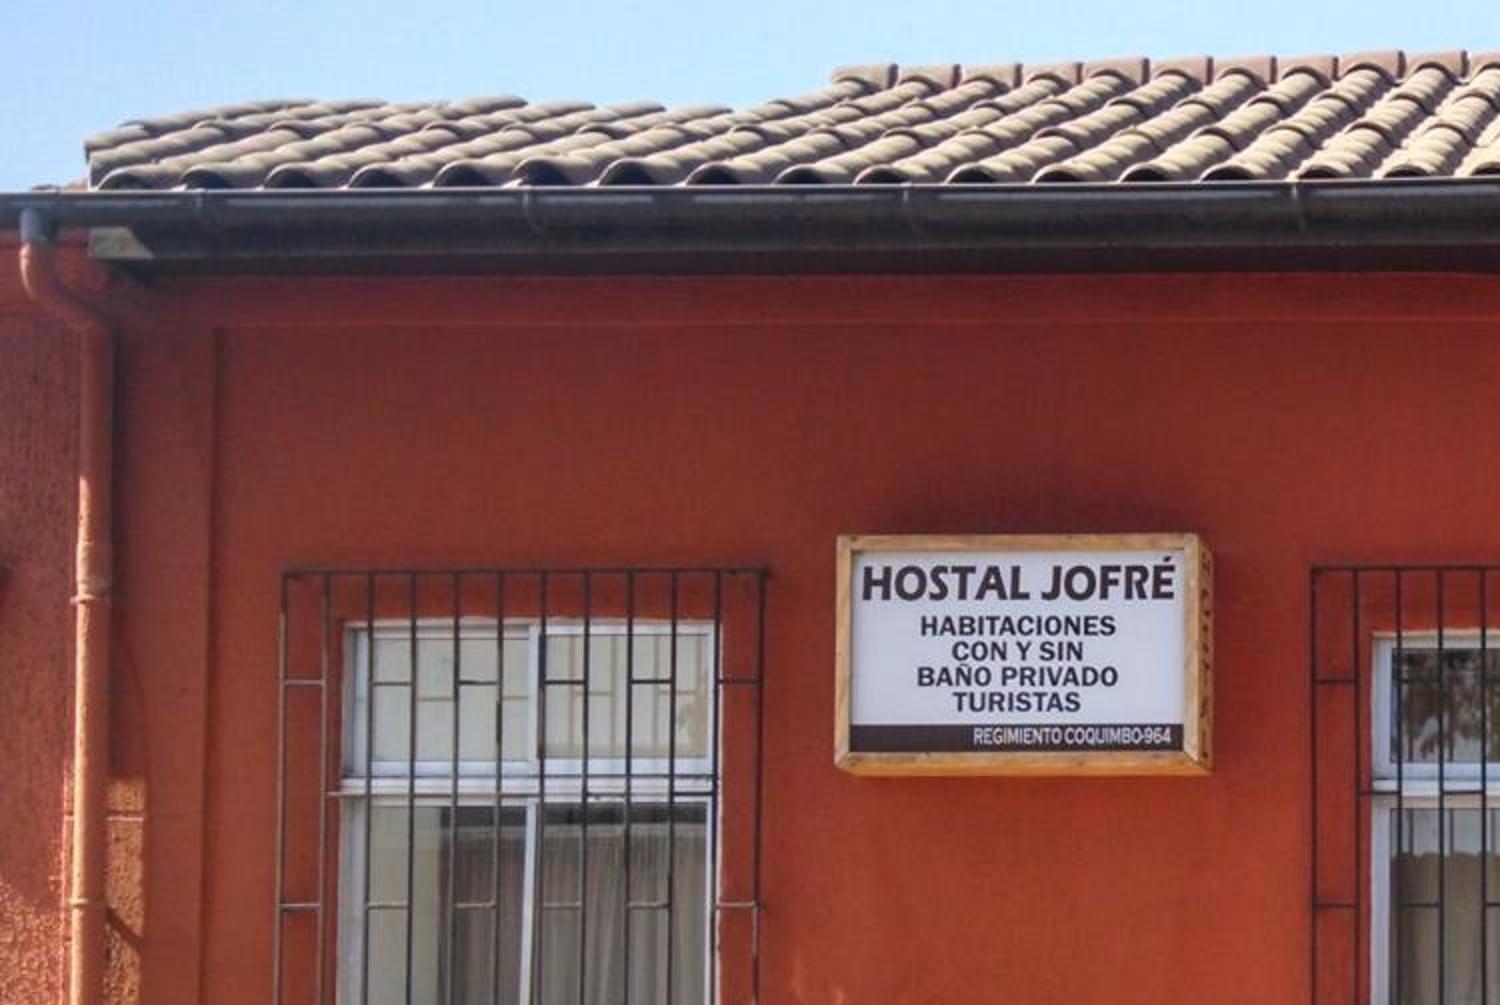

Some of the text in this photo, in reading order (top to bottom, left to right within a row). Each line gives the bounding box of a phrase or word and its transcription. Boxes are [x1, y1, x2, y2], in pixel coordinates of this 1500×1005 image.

[862, 556, 1176, 601] HOSTAL JOFRÉ
[920, 616, 1117, 637] HABITACIONES
[951, 641, 1083, 662] CON Y SIN
[917, 664, 1119, 687] BAÑO PRIVADO
[952, 691, 1081, 713] TURISTAS
[973, 727, 1062, 745] REGIMIENTO
